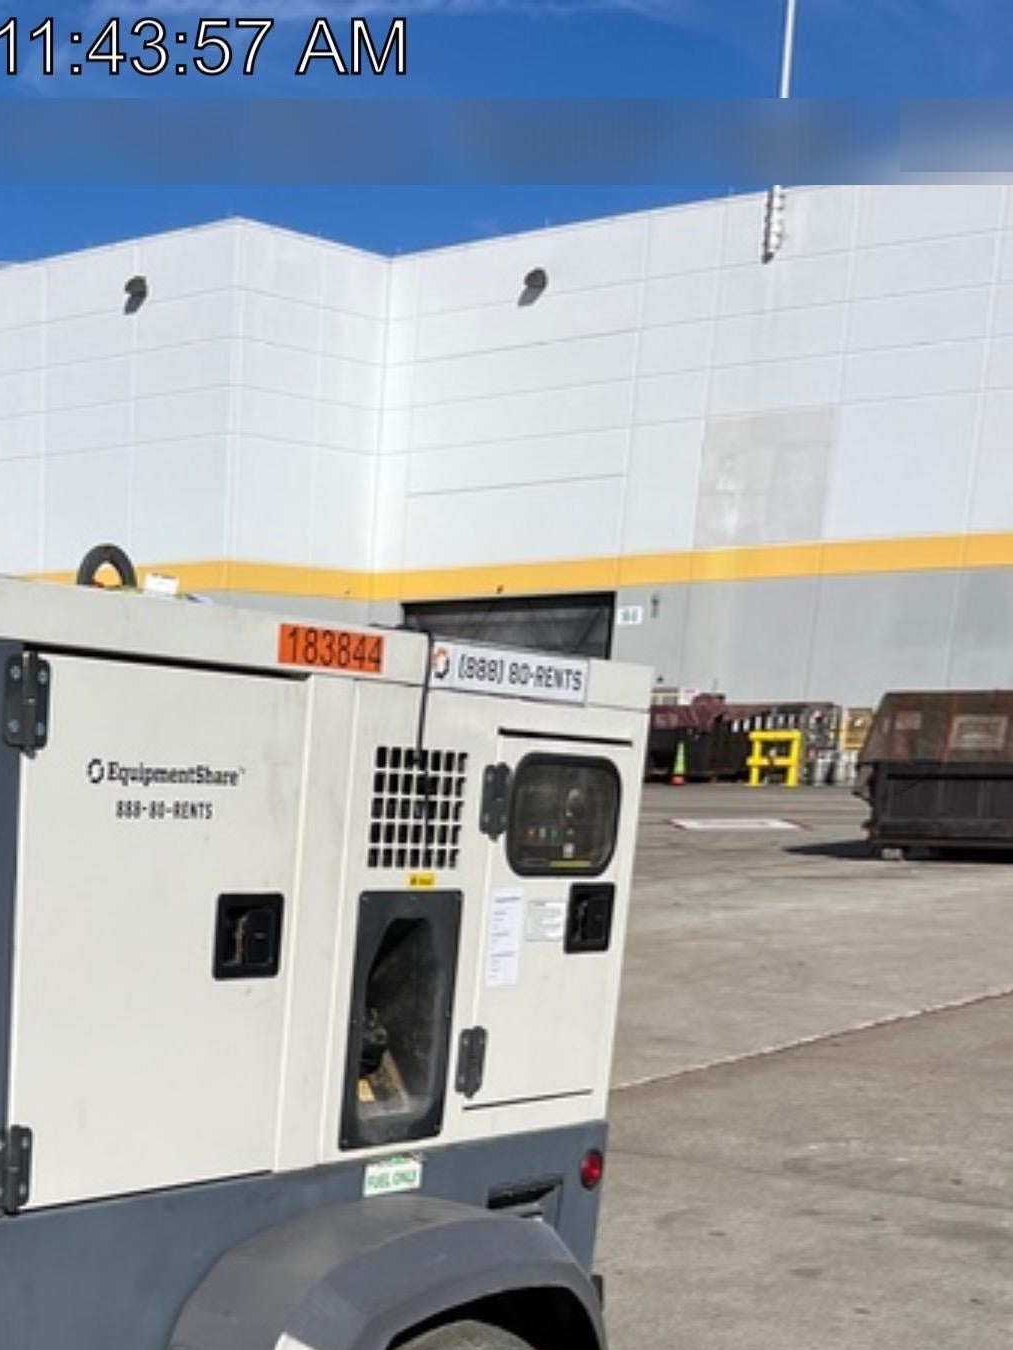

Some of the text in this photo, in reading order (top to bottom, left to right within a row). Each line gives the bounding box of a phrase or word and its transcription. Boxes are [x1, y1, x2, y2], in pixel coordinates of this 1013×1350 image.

[289, 626, 381, 672] 183844
[458, 654, 582, 691] (888) 80-RENTS
[107, 761, 239, 786] EquipmentShare
[116, 800, 213, 819] 888-80-RENTS
